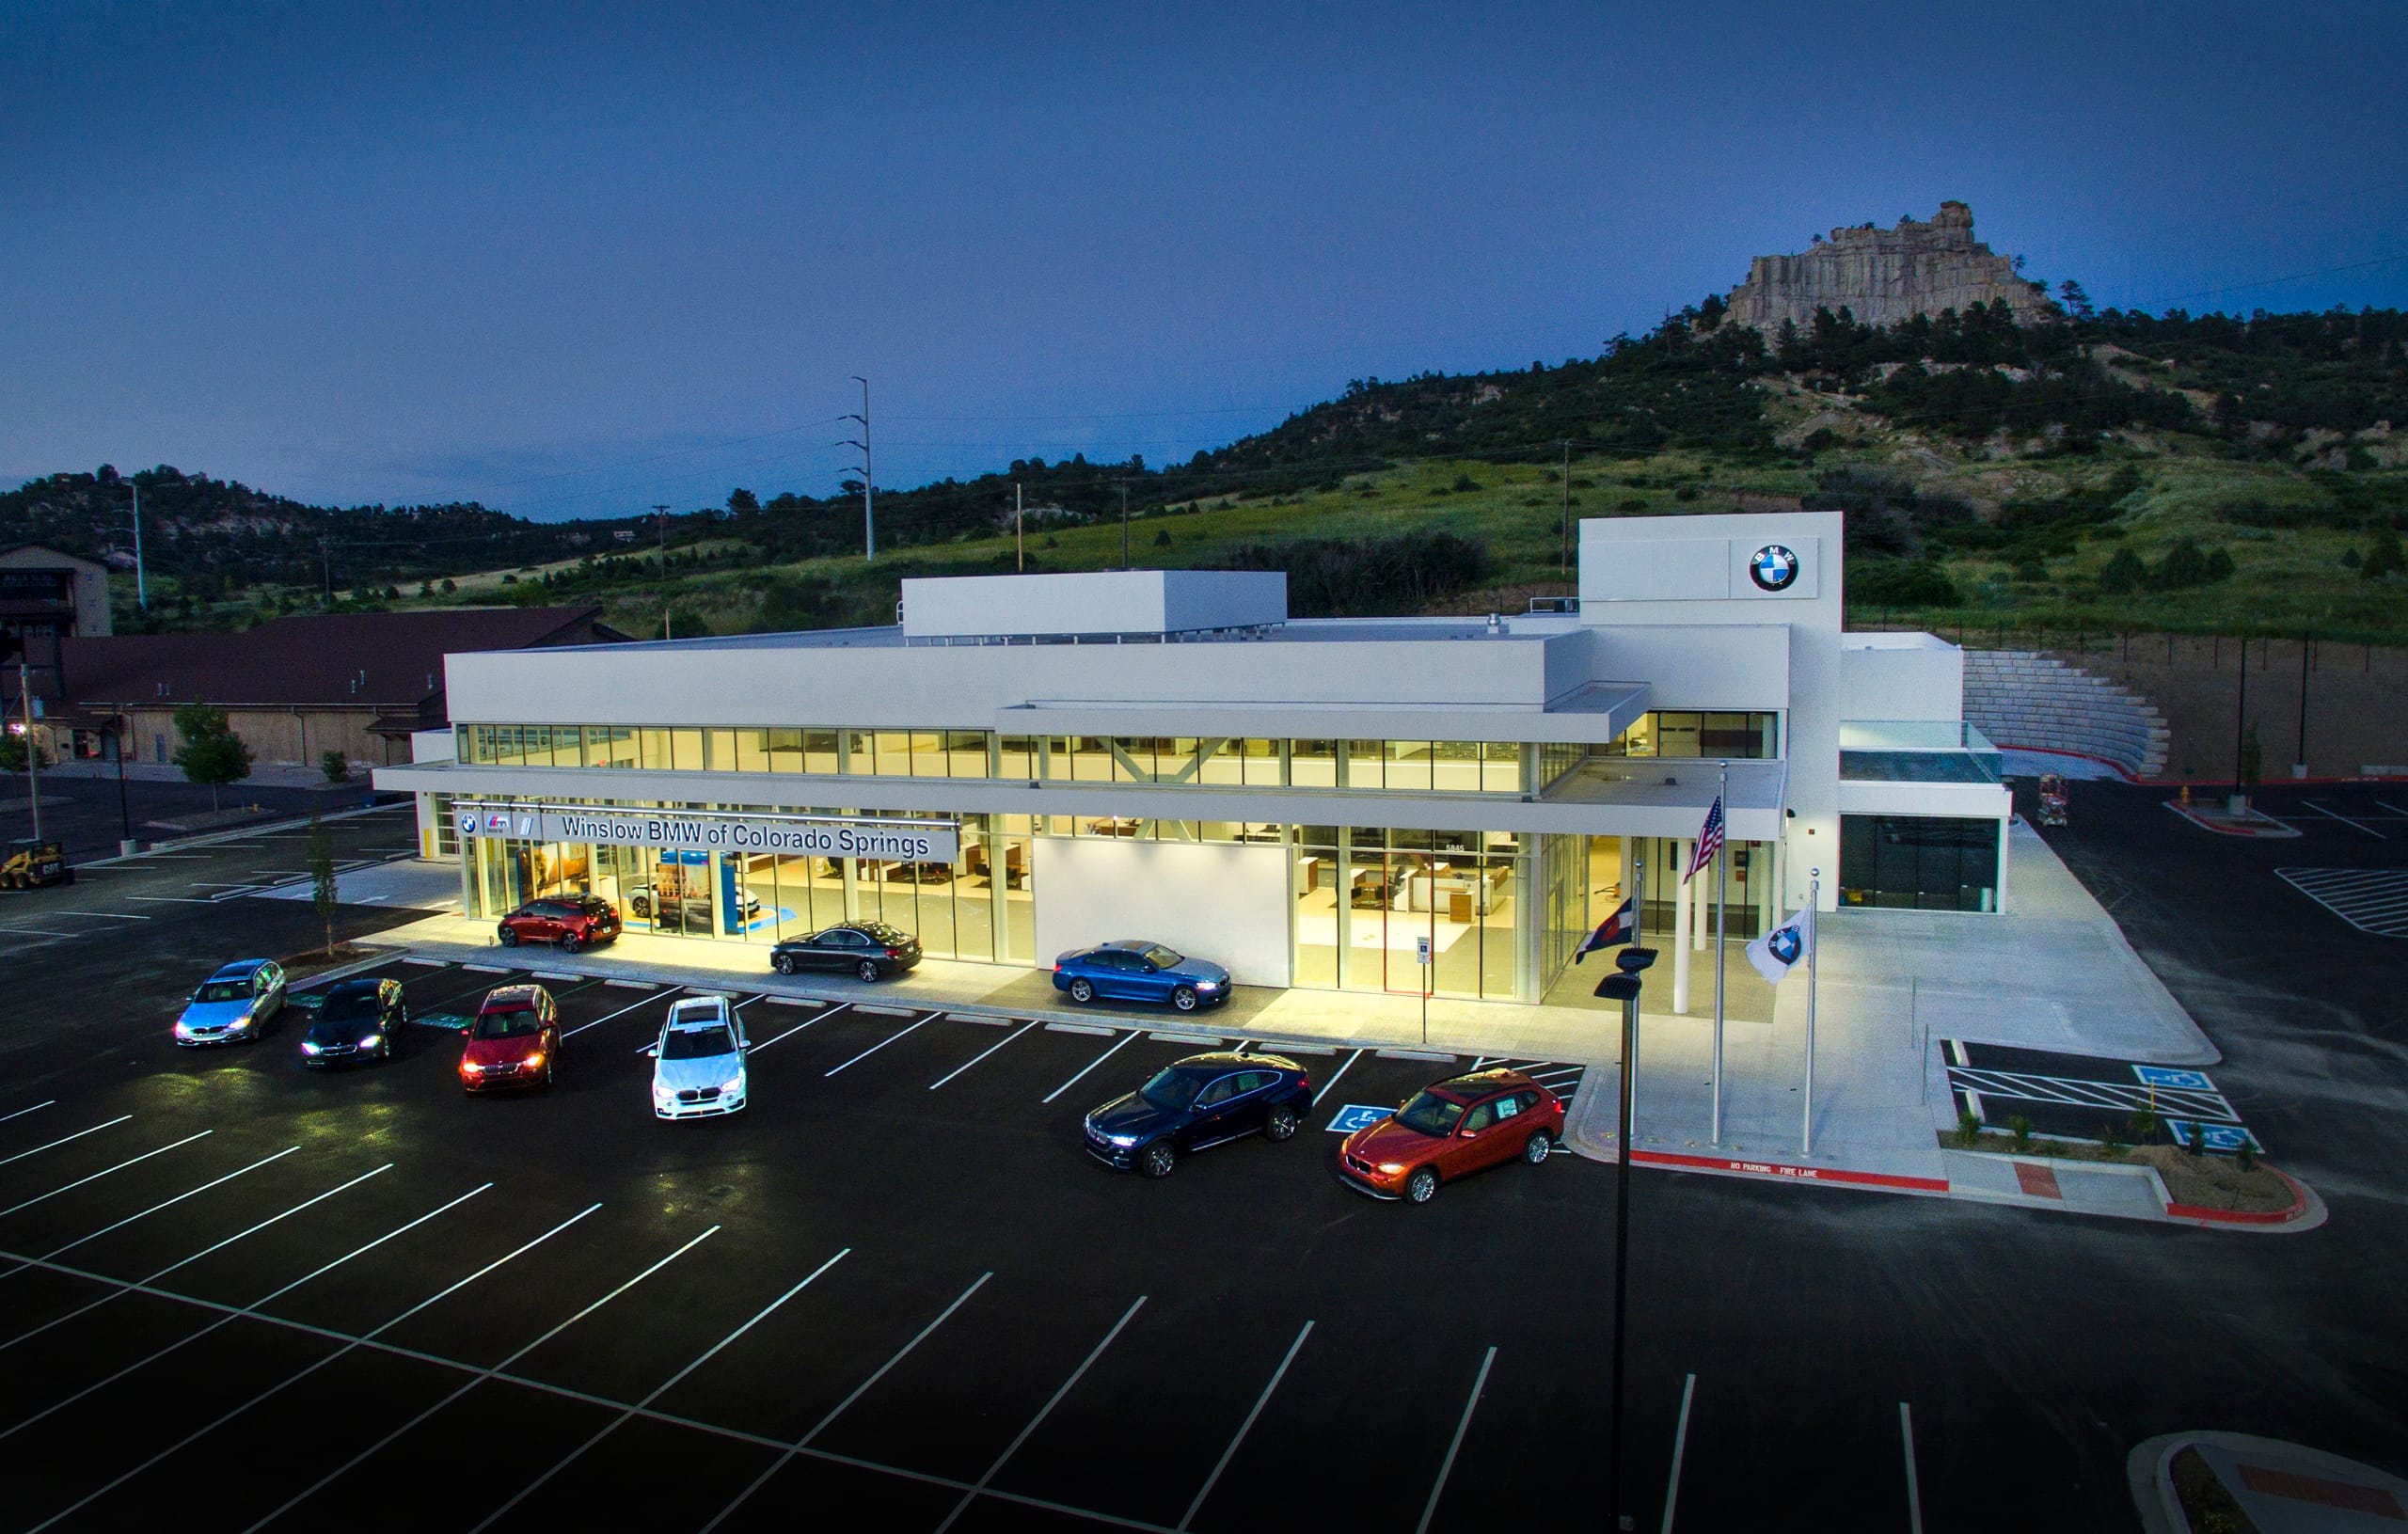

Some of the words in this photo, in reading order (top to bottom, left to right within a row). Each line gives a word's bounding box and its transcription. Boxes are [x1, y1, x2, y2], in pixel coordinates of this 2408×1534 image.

[1754, 546, 1795, 562] BMW
[562, 816, 642, 839] Winslow
[648, 821, 702, 843] BMW
[707, 825, 728, 844] of
[734, 825, 832, 849] Colorado
[839, 830, 929, 859] Springs
[43, 862, 60, 875] CAT
[1731, 1162, 1740, 1170] NO
[1742, 1163, 1771, 1173] PARKING
[1780, 1167, 1796, 1176] FIRE
[1798, 1169, 1817, 1178] LANE
